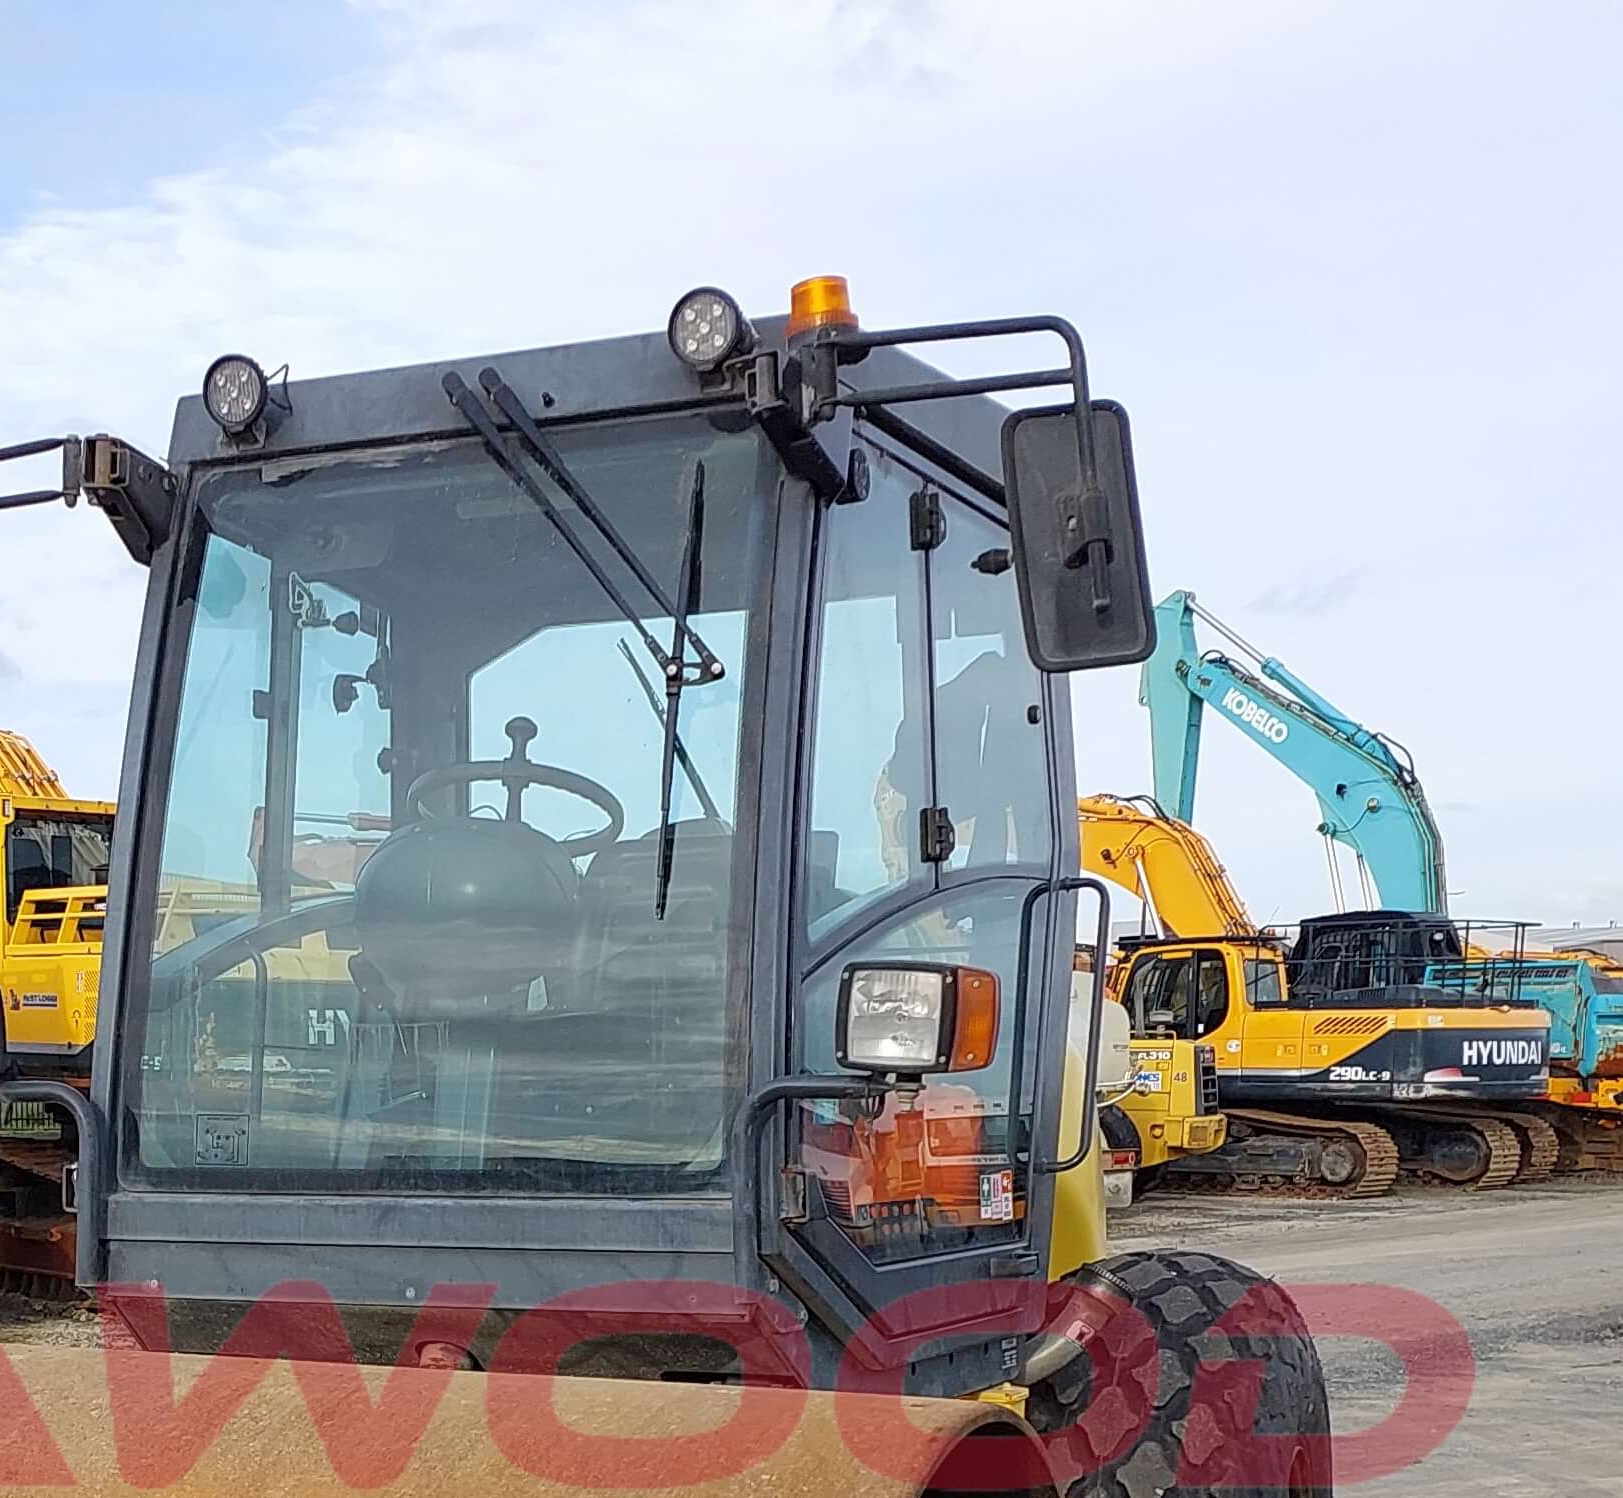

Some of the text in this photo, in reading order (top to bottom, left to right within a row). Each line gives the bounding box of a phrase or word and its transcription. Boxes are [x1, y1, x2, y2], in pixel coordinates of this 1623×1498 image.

[1222, 686, 1289, 744] KOBELCO
[1462, 1041, 1542, 1065] HYUNDAI
[1174, 1072, 1188, 1083] 48
[1329, 1066, 1391, 1082] 290LC-9
